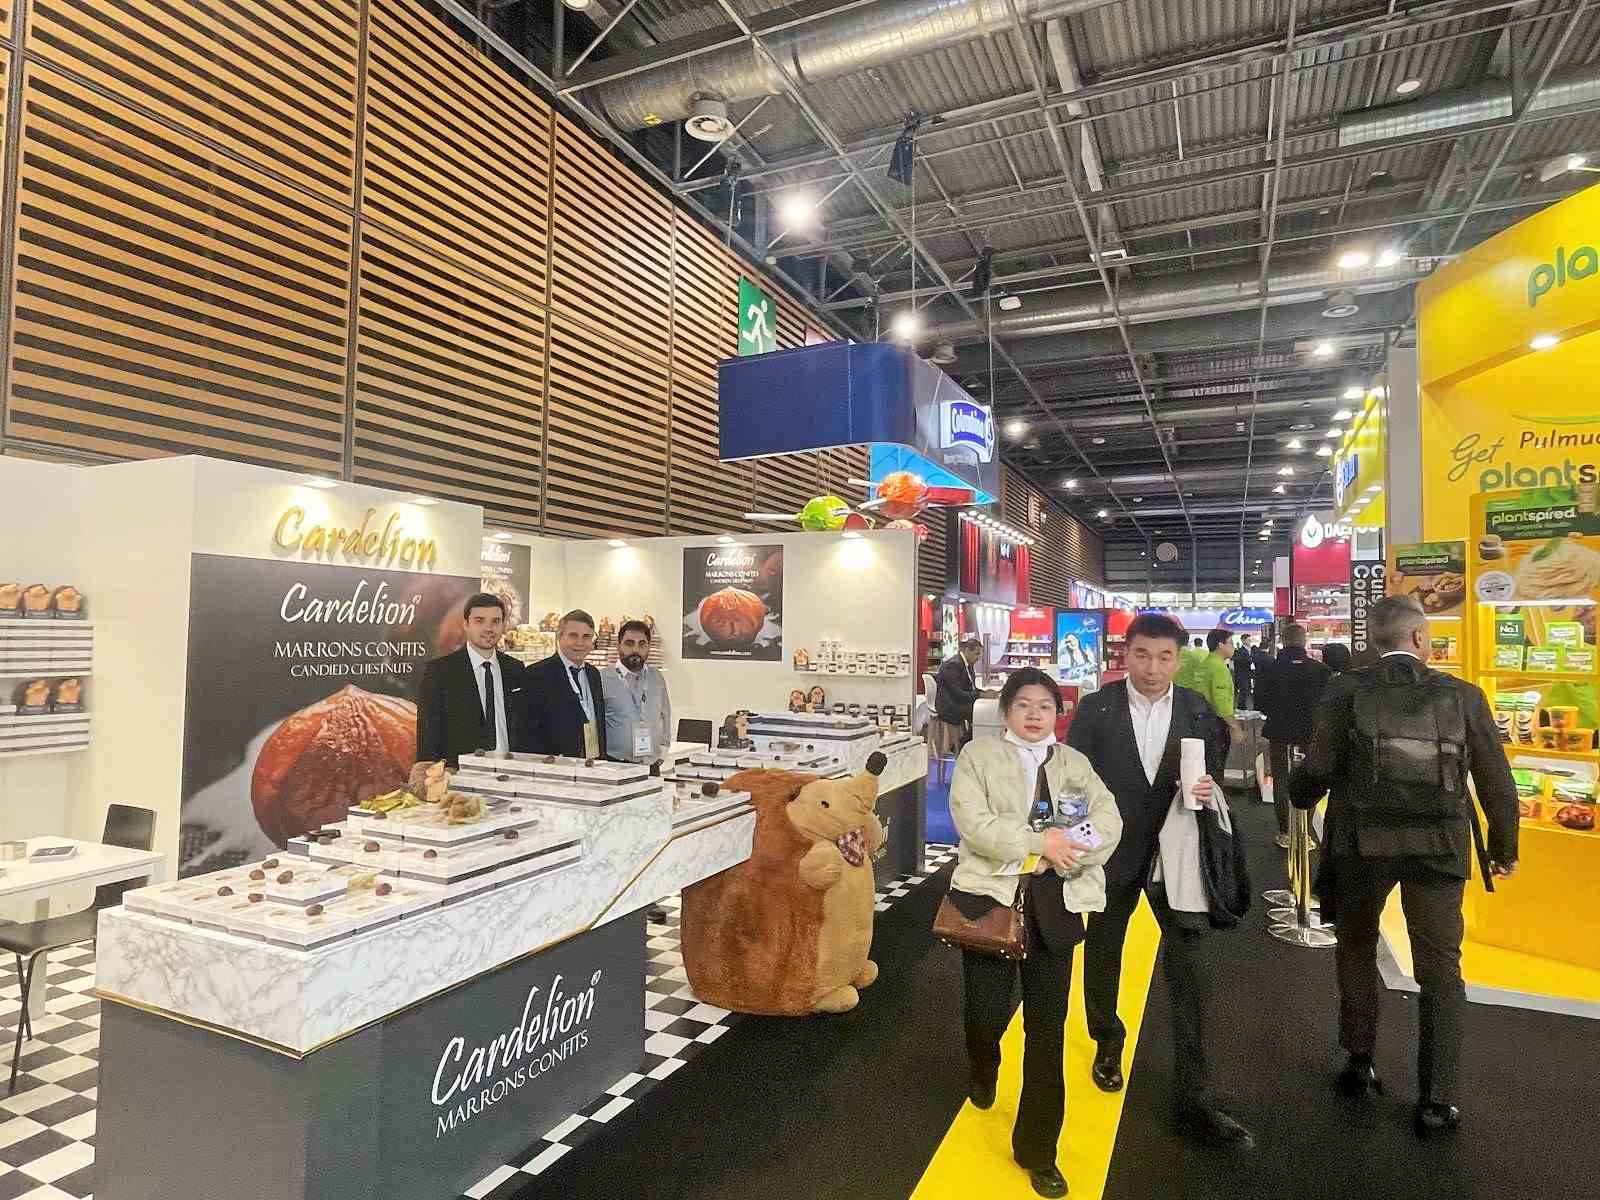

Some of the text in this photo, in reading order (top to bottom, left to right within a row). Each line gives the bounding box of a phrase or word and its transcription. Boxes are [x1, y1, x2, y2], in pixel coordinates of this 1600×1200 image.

[1448, 433, 1504, 481] Get
[1480, 458, 1600, 492] plants
[273, 505, 438, 563] Cardelion
[1492, 507, 1576, 528] plantspired
[280, 580, 416, 625] Cardelion
[1354, 564, 1374, 652] Coréenne
[274, 641, 426, 658] MARRONS CONFITS
[290, 662, 413, 678] CANDIED CHESTNUTS
[431, 974, 596, 1106] Cardelion
[436, 1029, 589, 1139] MARRONS CONFITS
